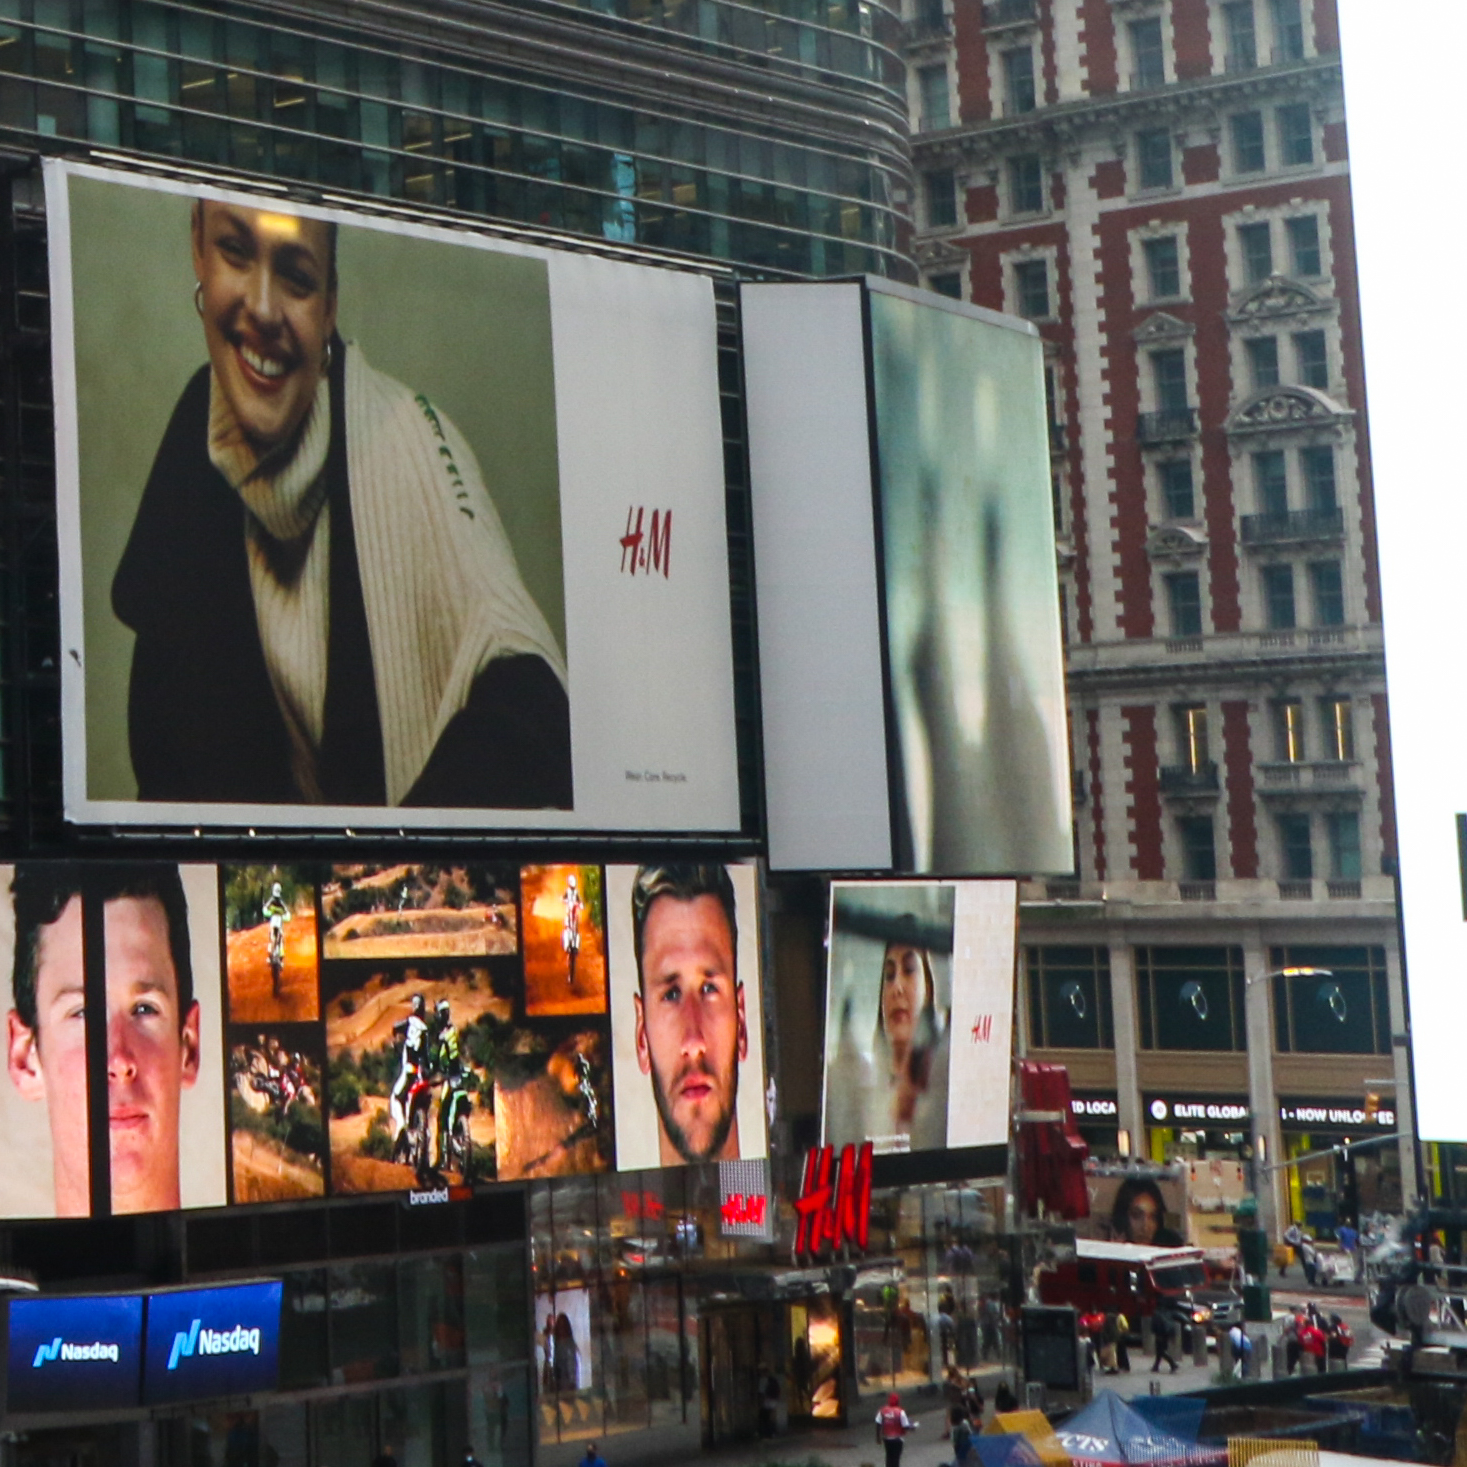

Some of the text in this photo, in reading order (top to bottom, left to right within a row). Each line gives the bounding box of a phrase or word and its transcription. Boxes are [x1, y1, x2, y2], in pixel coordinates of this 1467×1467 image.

[1174, 1102, 1205, 1119] ELITE
[1296, 1107, 1327, 1123] NOW
[60, 1340, 119, 1363] Nasdaq
[198, 1324, 261, 1356] Nasdaq
